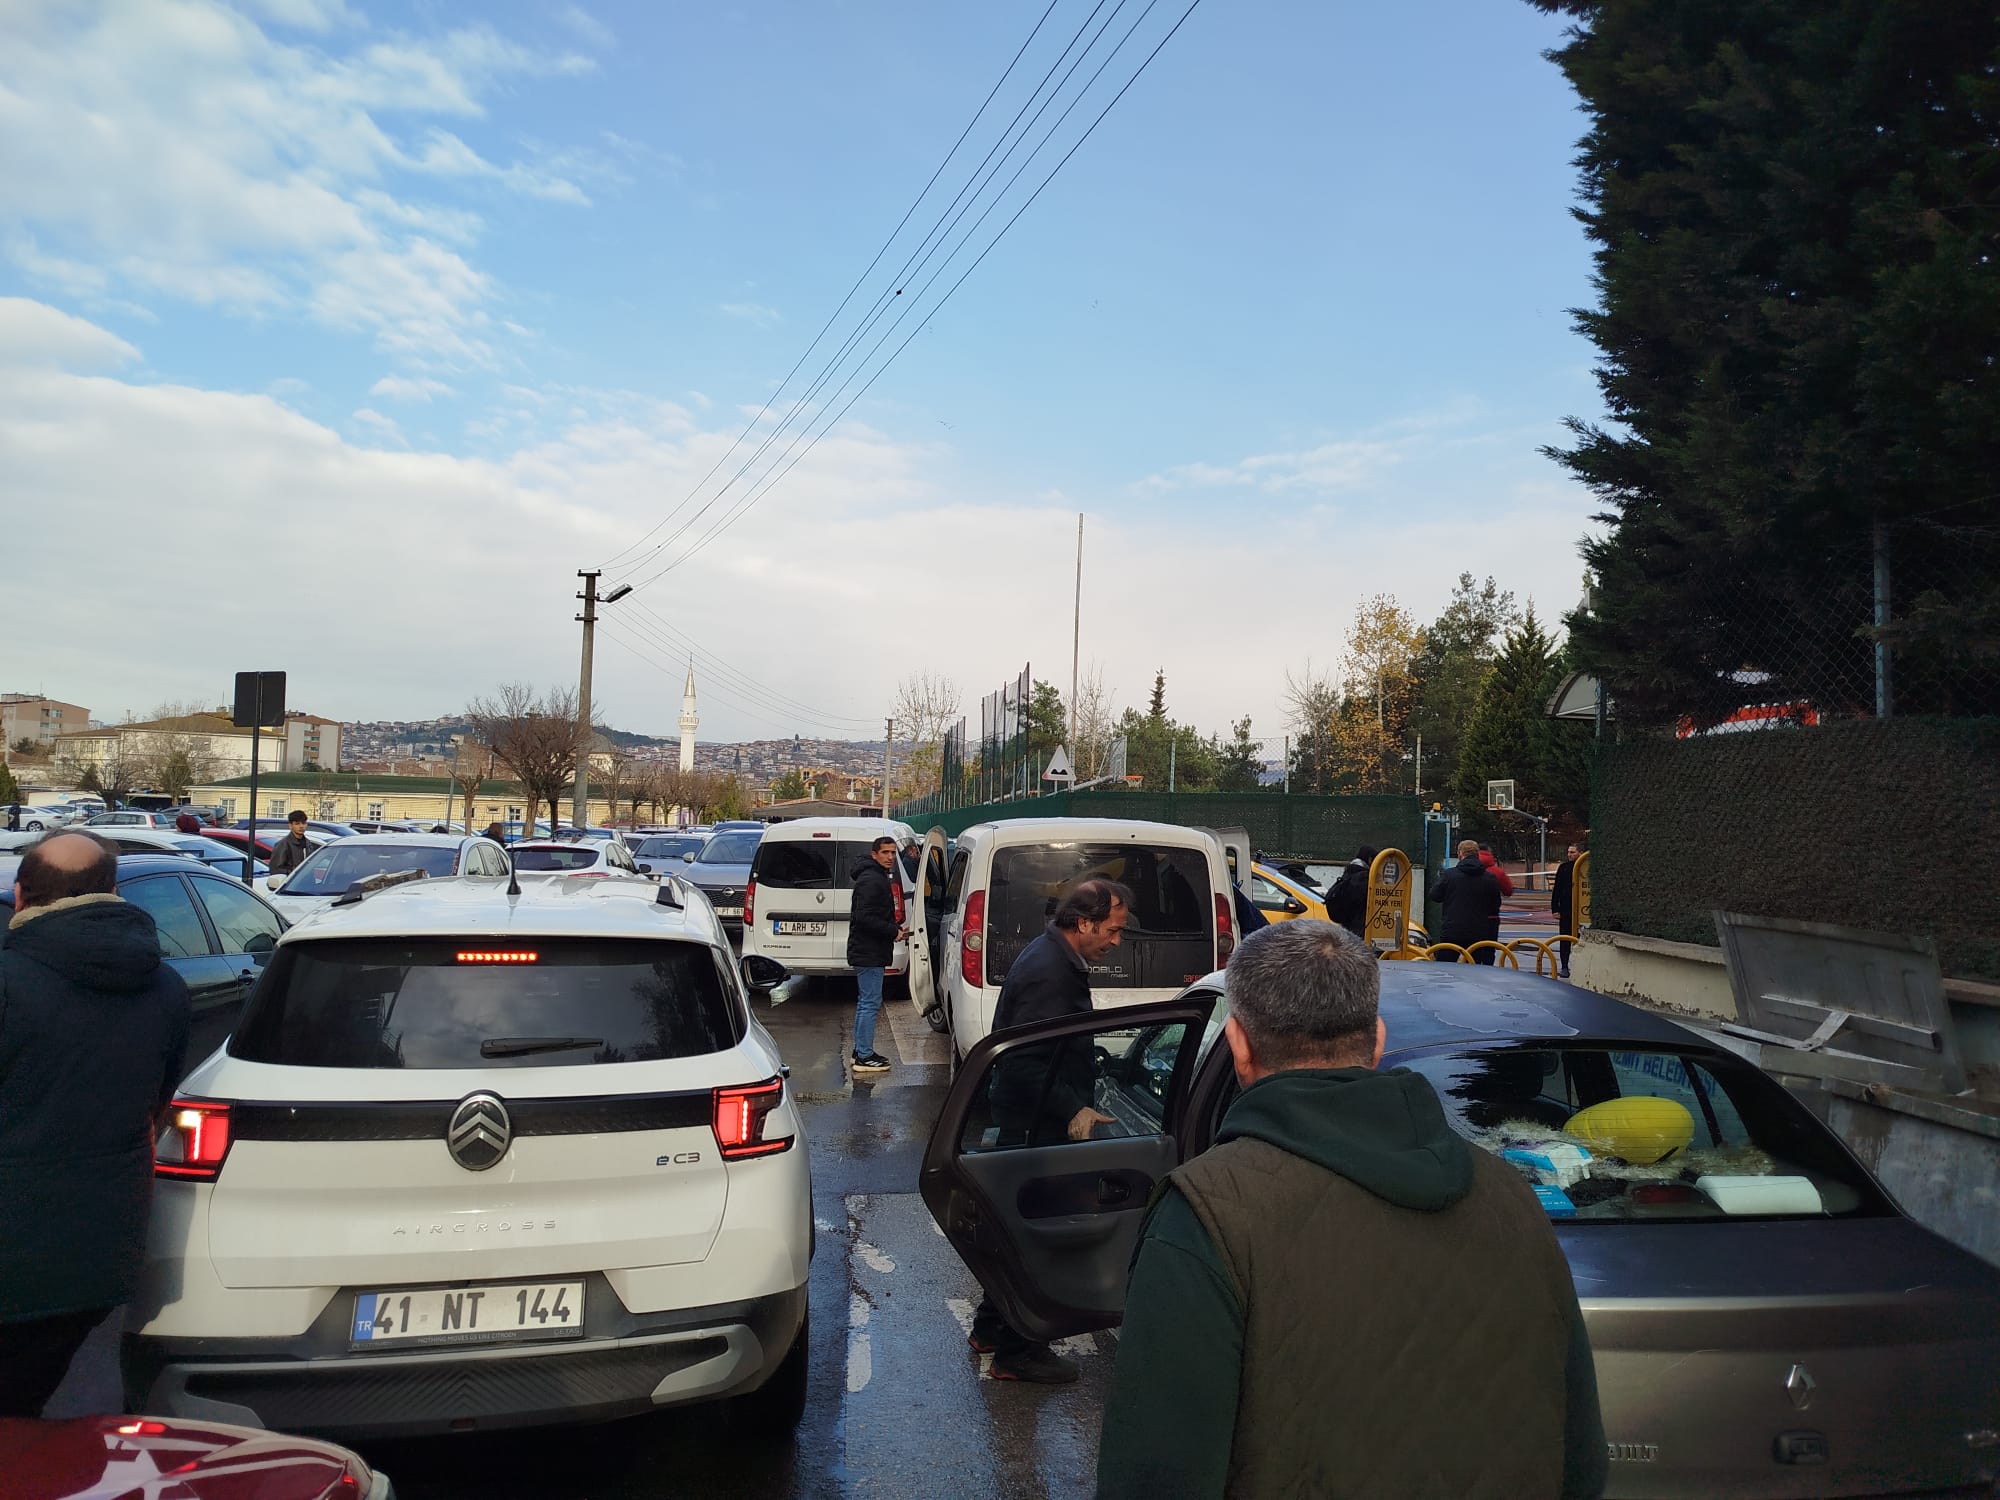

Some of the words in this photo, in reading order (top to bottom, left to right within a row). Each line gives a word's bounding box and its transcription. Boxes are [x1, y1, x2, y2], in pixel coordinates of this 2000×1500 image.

[779, 922, 788, 932] 41
[791, 922, 806, 932] ARH
[810, 922, 825, 932] 557
[392, 1220, 557, 1235] AIRCROSS
[374, 1296, 411, 1334] 41
[441, 1292, 485, 1330] NT
[516, 1287, 571, 1325] 144
[357, 1320, 372, 1332] TR
[1607, 1444, 1659, 1462] AULT
